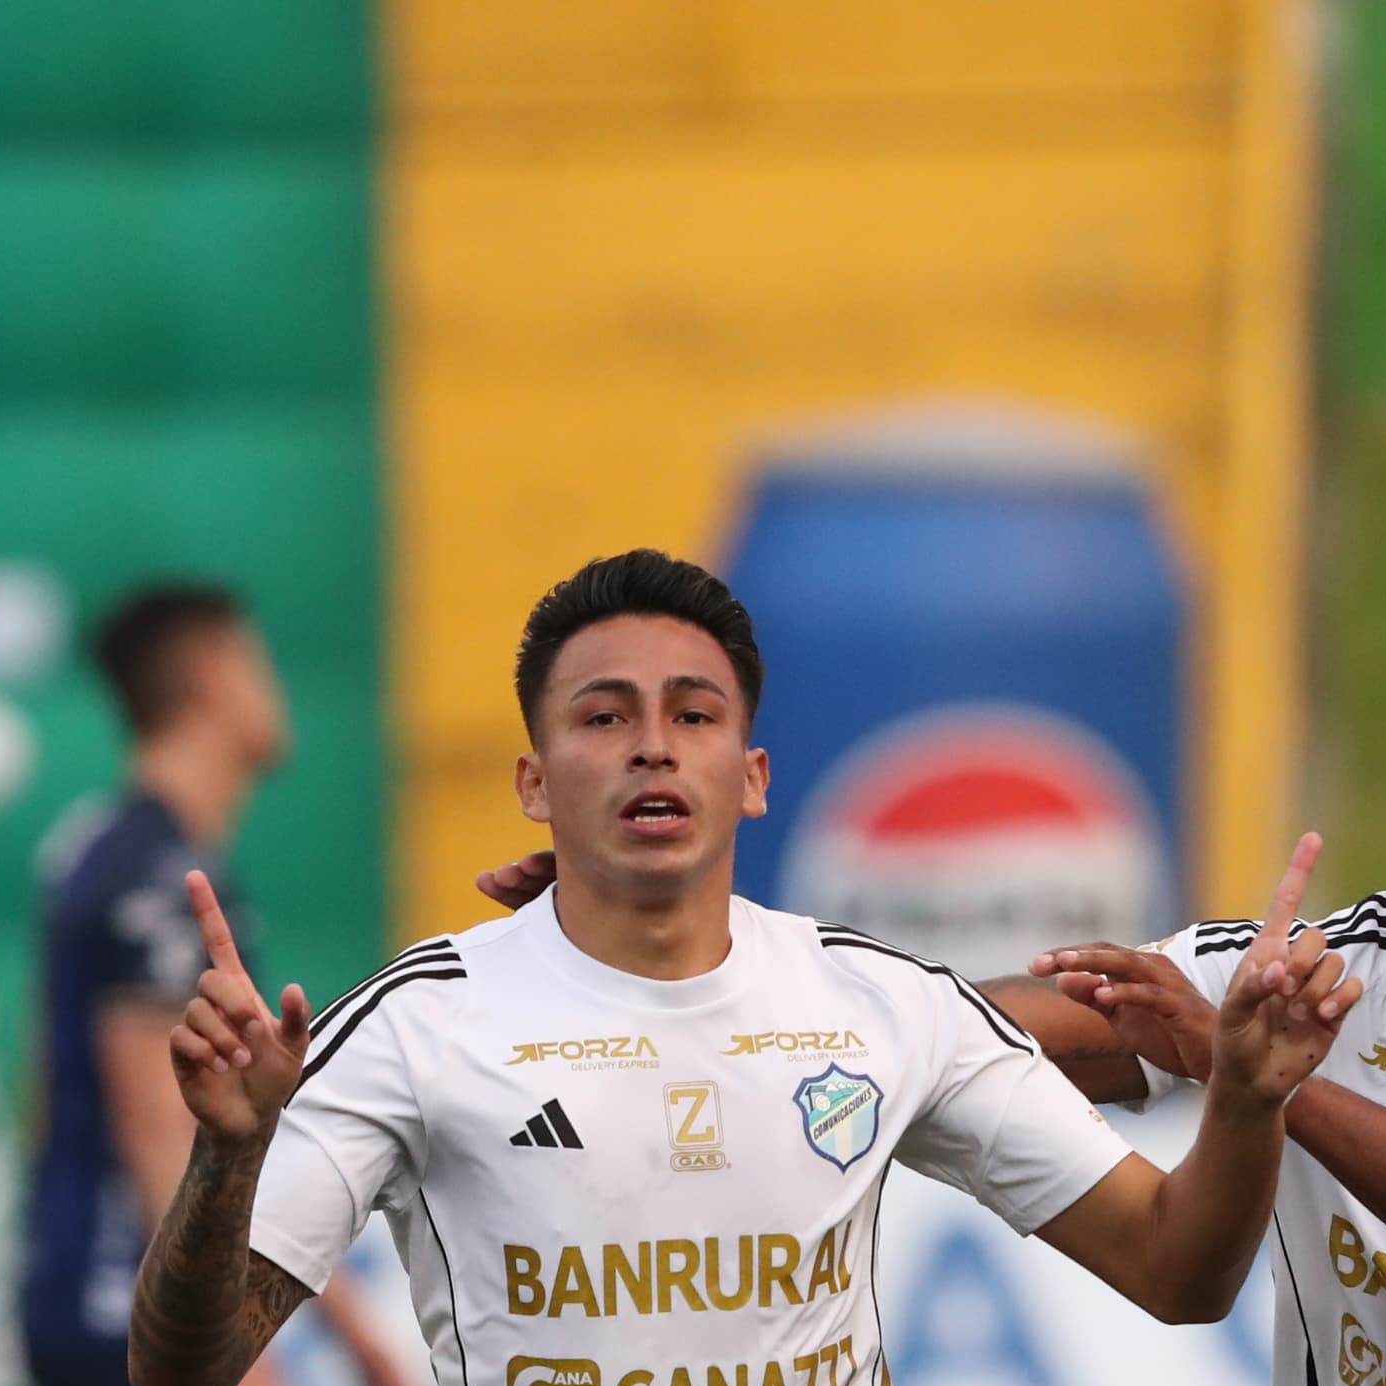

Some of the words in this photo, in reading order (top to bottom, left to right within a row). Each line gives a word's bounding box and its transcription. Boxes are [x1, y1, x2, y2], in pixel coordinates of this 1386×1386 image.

[536, 1036, 659, 1062] FORZA
[754, 1030, 866, 1055] FORZA
[570, 1061, 615, 1072] DELIVERY
[617, 1059, 661, 1070] EXPRESS
[786, 1053, 830, 1063] DELIVERY
[832, 1049, 870, 1061] EXPRESS
[669, 1087, 715, 1144] Z
[813, 1087, 873, 1141] COMUNICACIONES
[678, 1154, 718, 1167] GAS
[503, 1219, 853, 1318] BANRURAL
